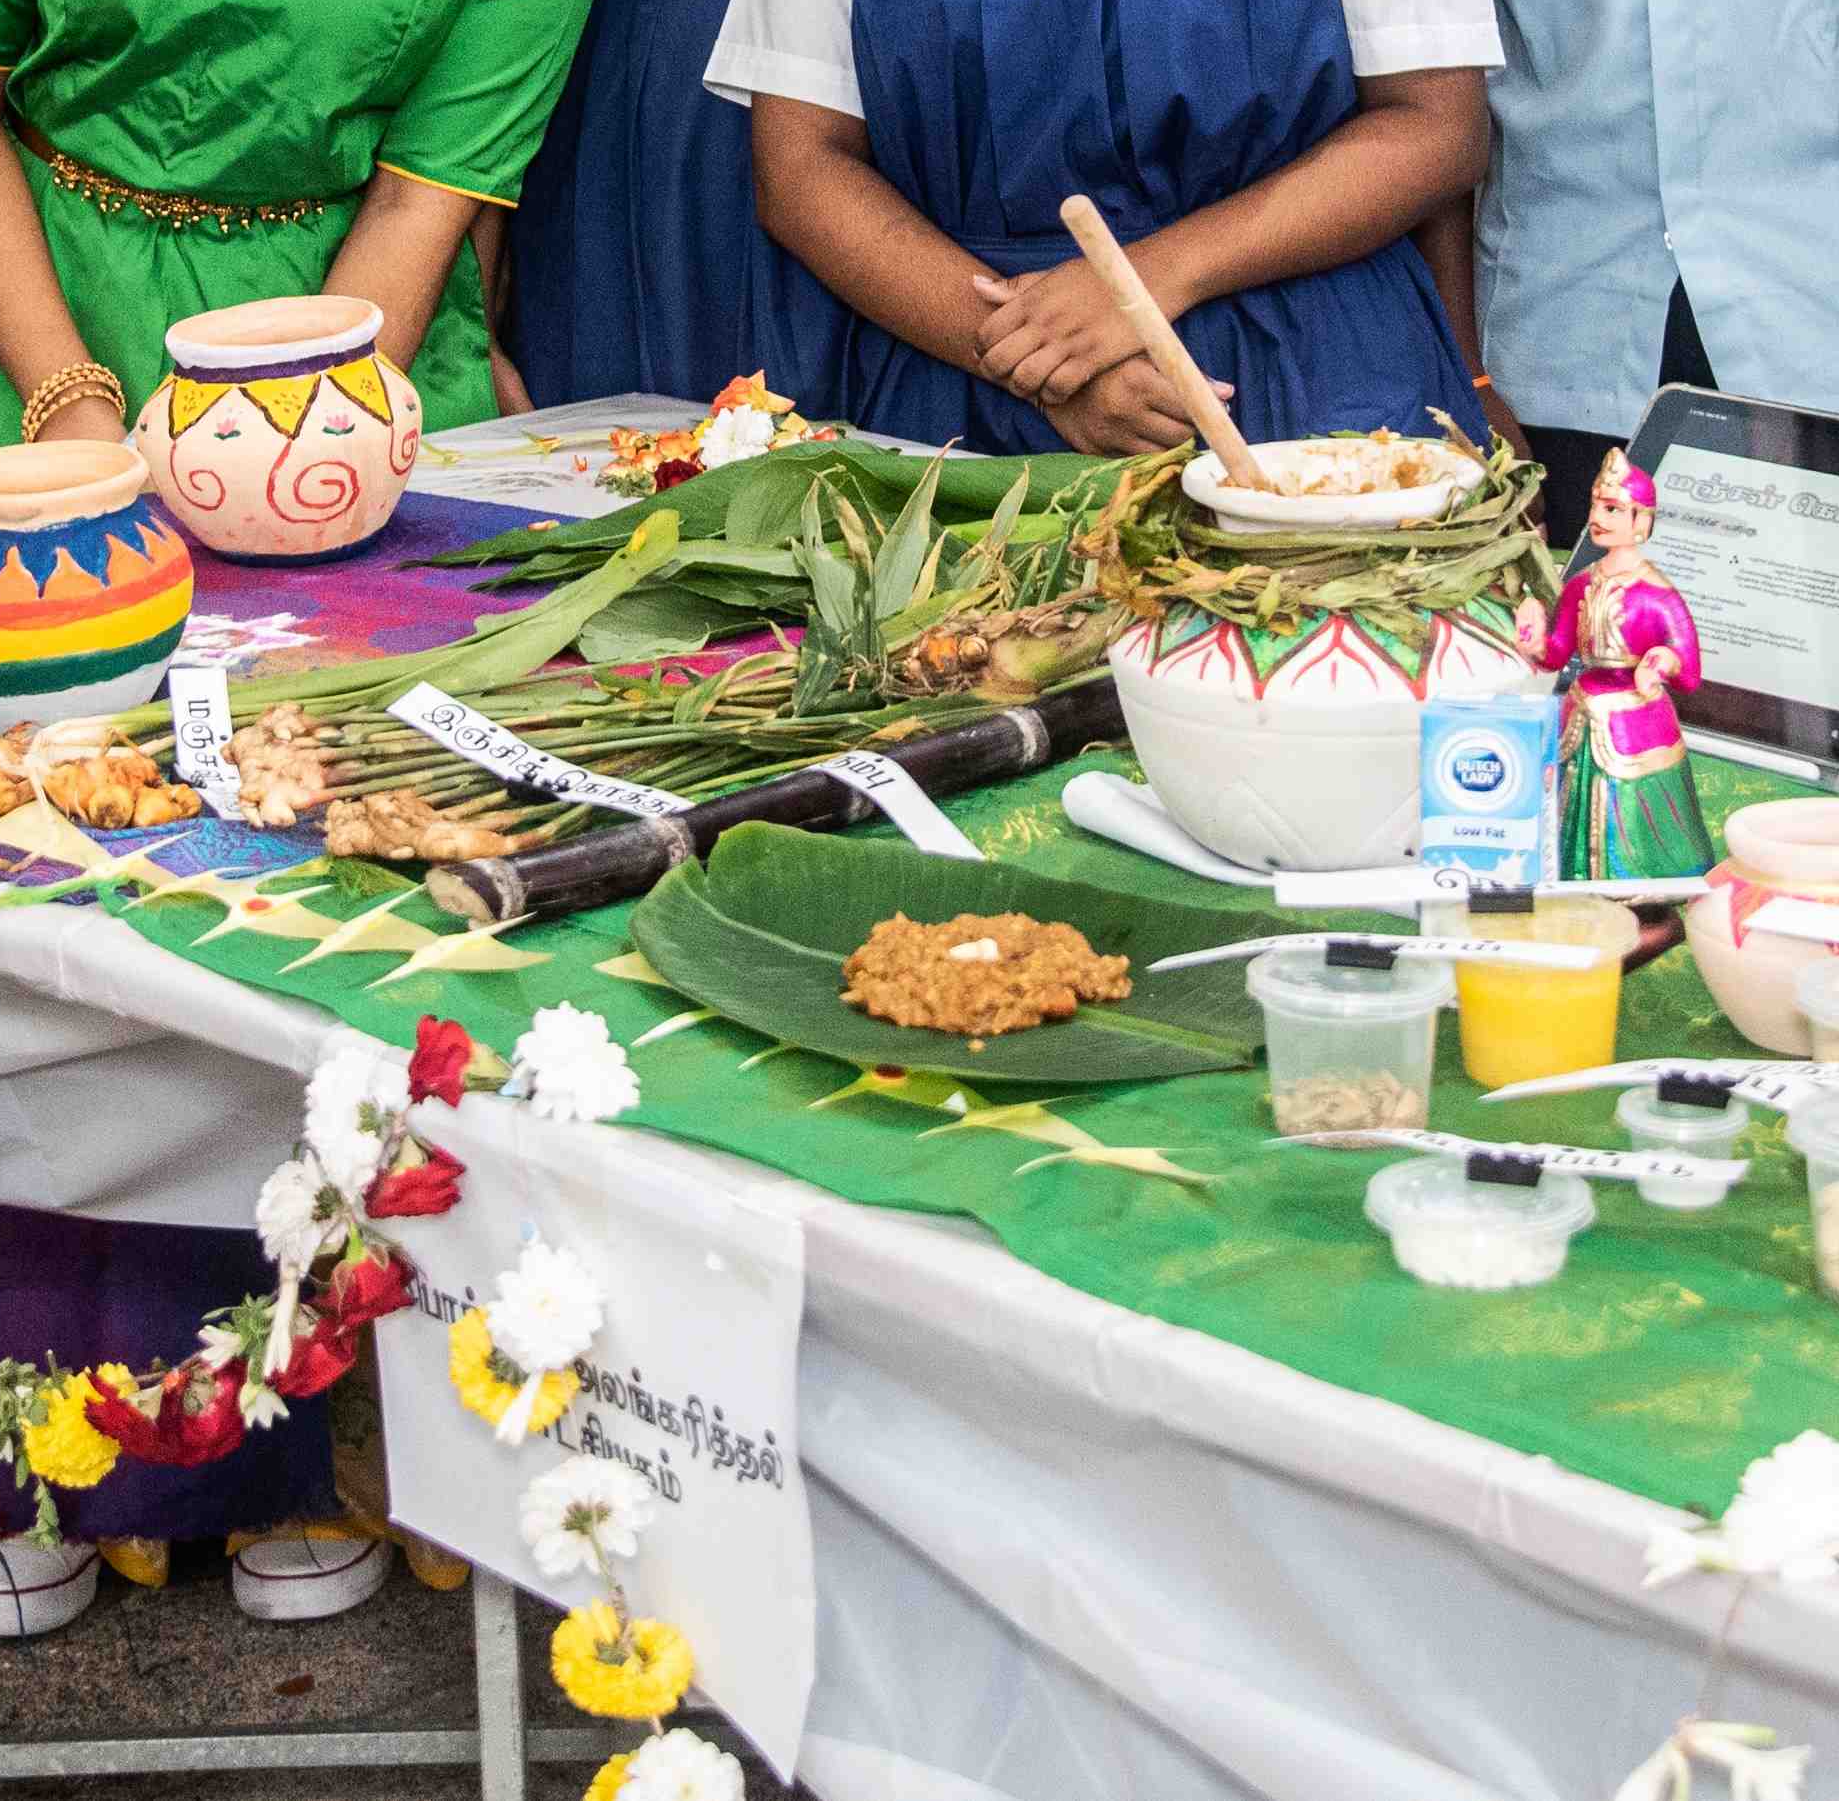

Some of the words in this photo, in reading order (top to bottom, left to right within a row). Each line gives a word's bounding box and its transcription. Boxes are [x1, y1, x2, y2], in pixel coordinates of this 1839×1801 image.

[1456, 759, 1501, 773] DUTCH
[1461, 772, 1496, 785] LADY
[1454, 825, 1481, 836] Low
[1486, 826, 1506, 839] Fat
[573, 1356, 784, 1491] அலங்கரித்தல்
